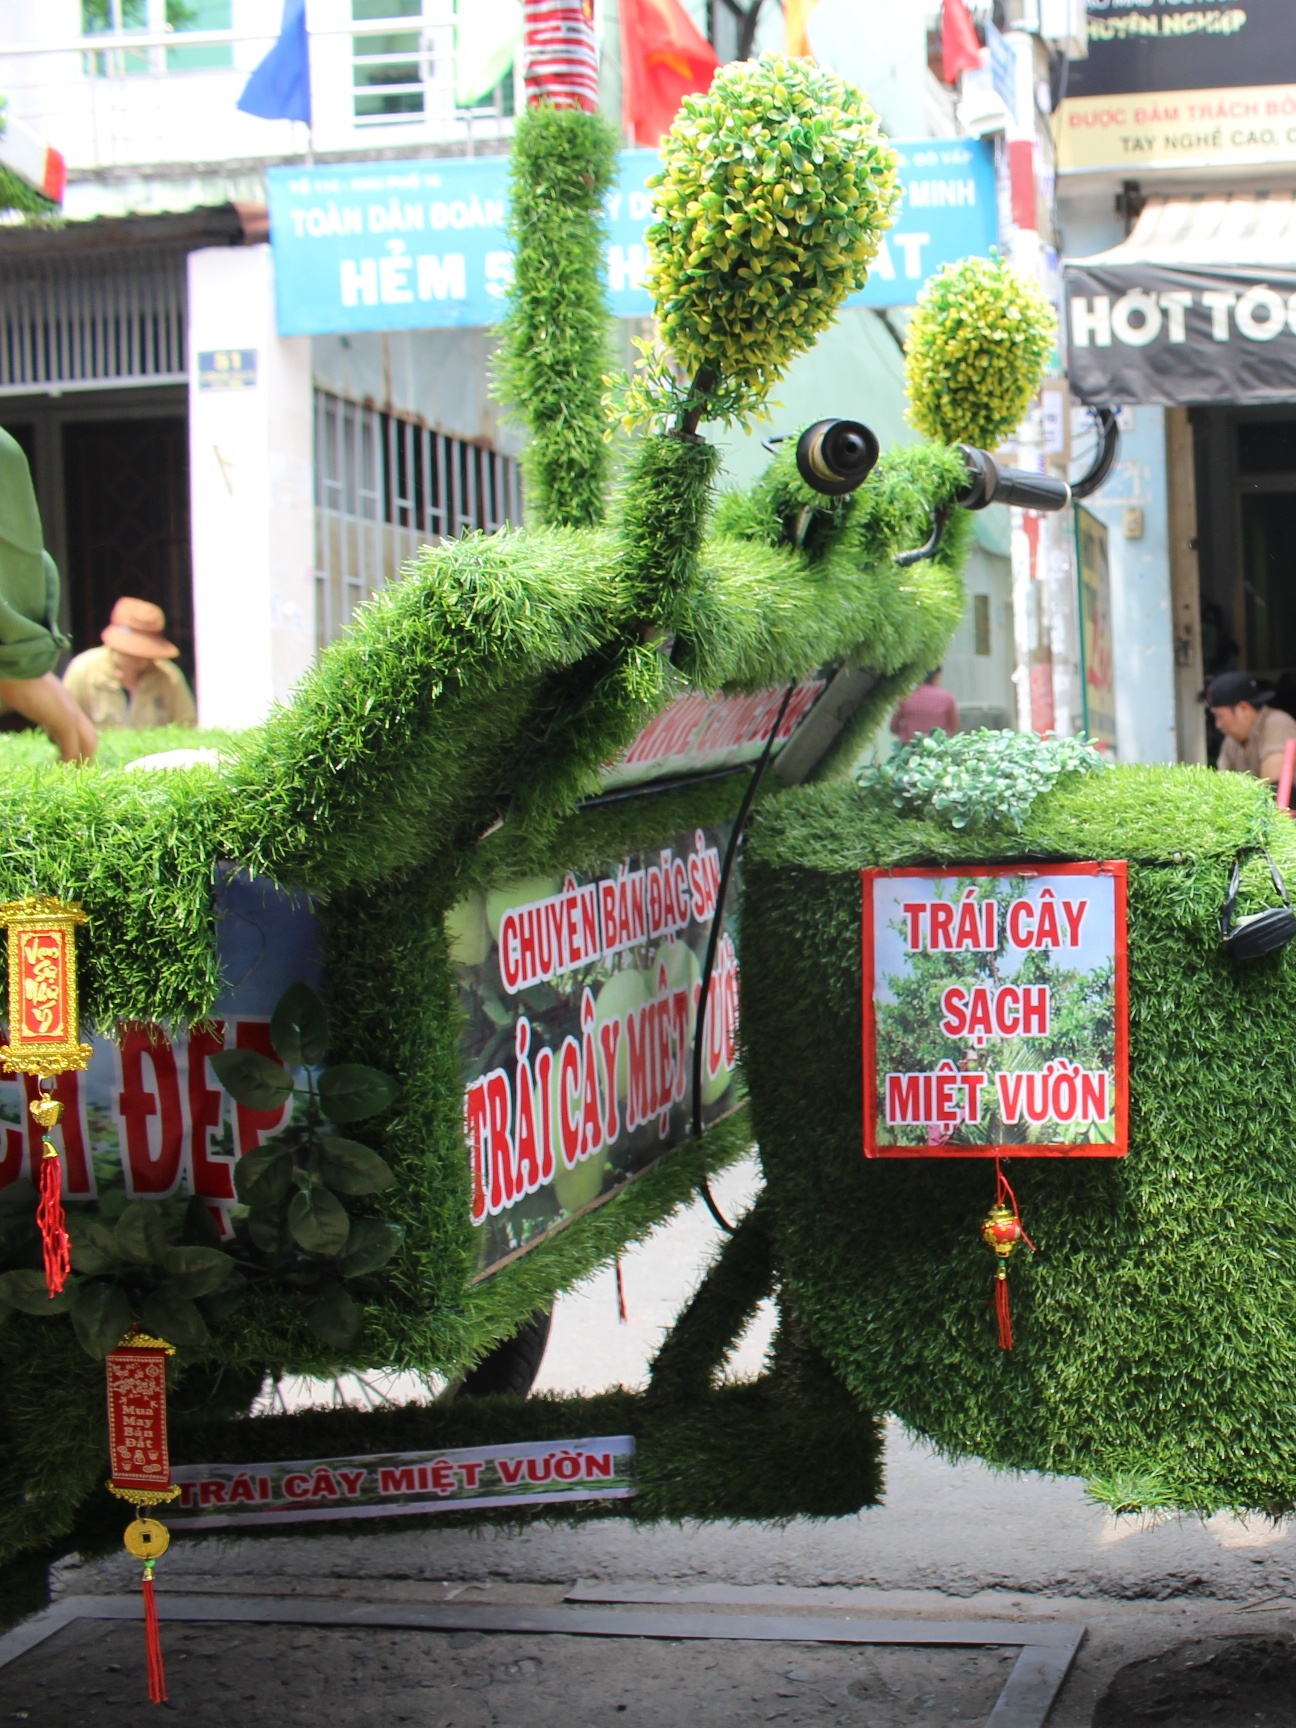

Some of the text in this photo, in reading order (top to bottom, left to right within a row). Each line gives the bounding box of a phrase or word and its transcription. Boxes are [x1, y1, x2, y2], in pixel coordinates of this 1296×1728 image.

[1088, 11, 1158, 40] HUYÊN
[1121, 136, 1155, 154] TAY
[290, 192, 504, 238] TOÀN DÂN ĐOÀN
[909, 179, 975, 208] MINH
[340, 238, 466, 307] HẺM
[1070, 286, 1192, 347] HỚT
[502, 877, 598, 988] CHUYÊN
[602, 865, 646, 949] BÁN
[649, 857, 689, 943] ĐẶC
[904, 889, 1087, 949] TRÁI CÂY
[942, 988, 1047, 1045] SẠCH
[561, 994, 619, 1164] CÂY
[627, 963, 688, 1135] MIỆT
[890, 1061, 1105, 1131] MIỆT VƯỜN
[122, 1405, 154, 1416] Mua
[123, 1416, 153, 1428] May
[179, 1450, 613, 1509] TRÁI CÂY MIỆT VƯỜN
